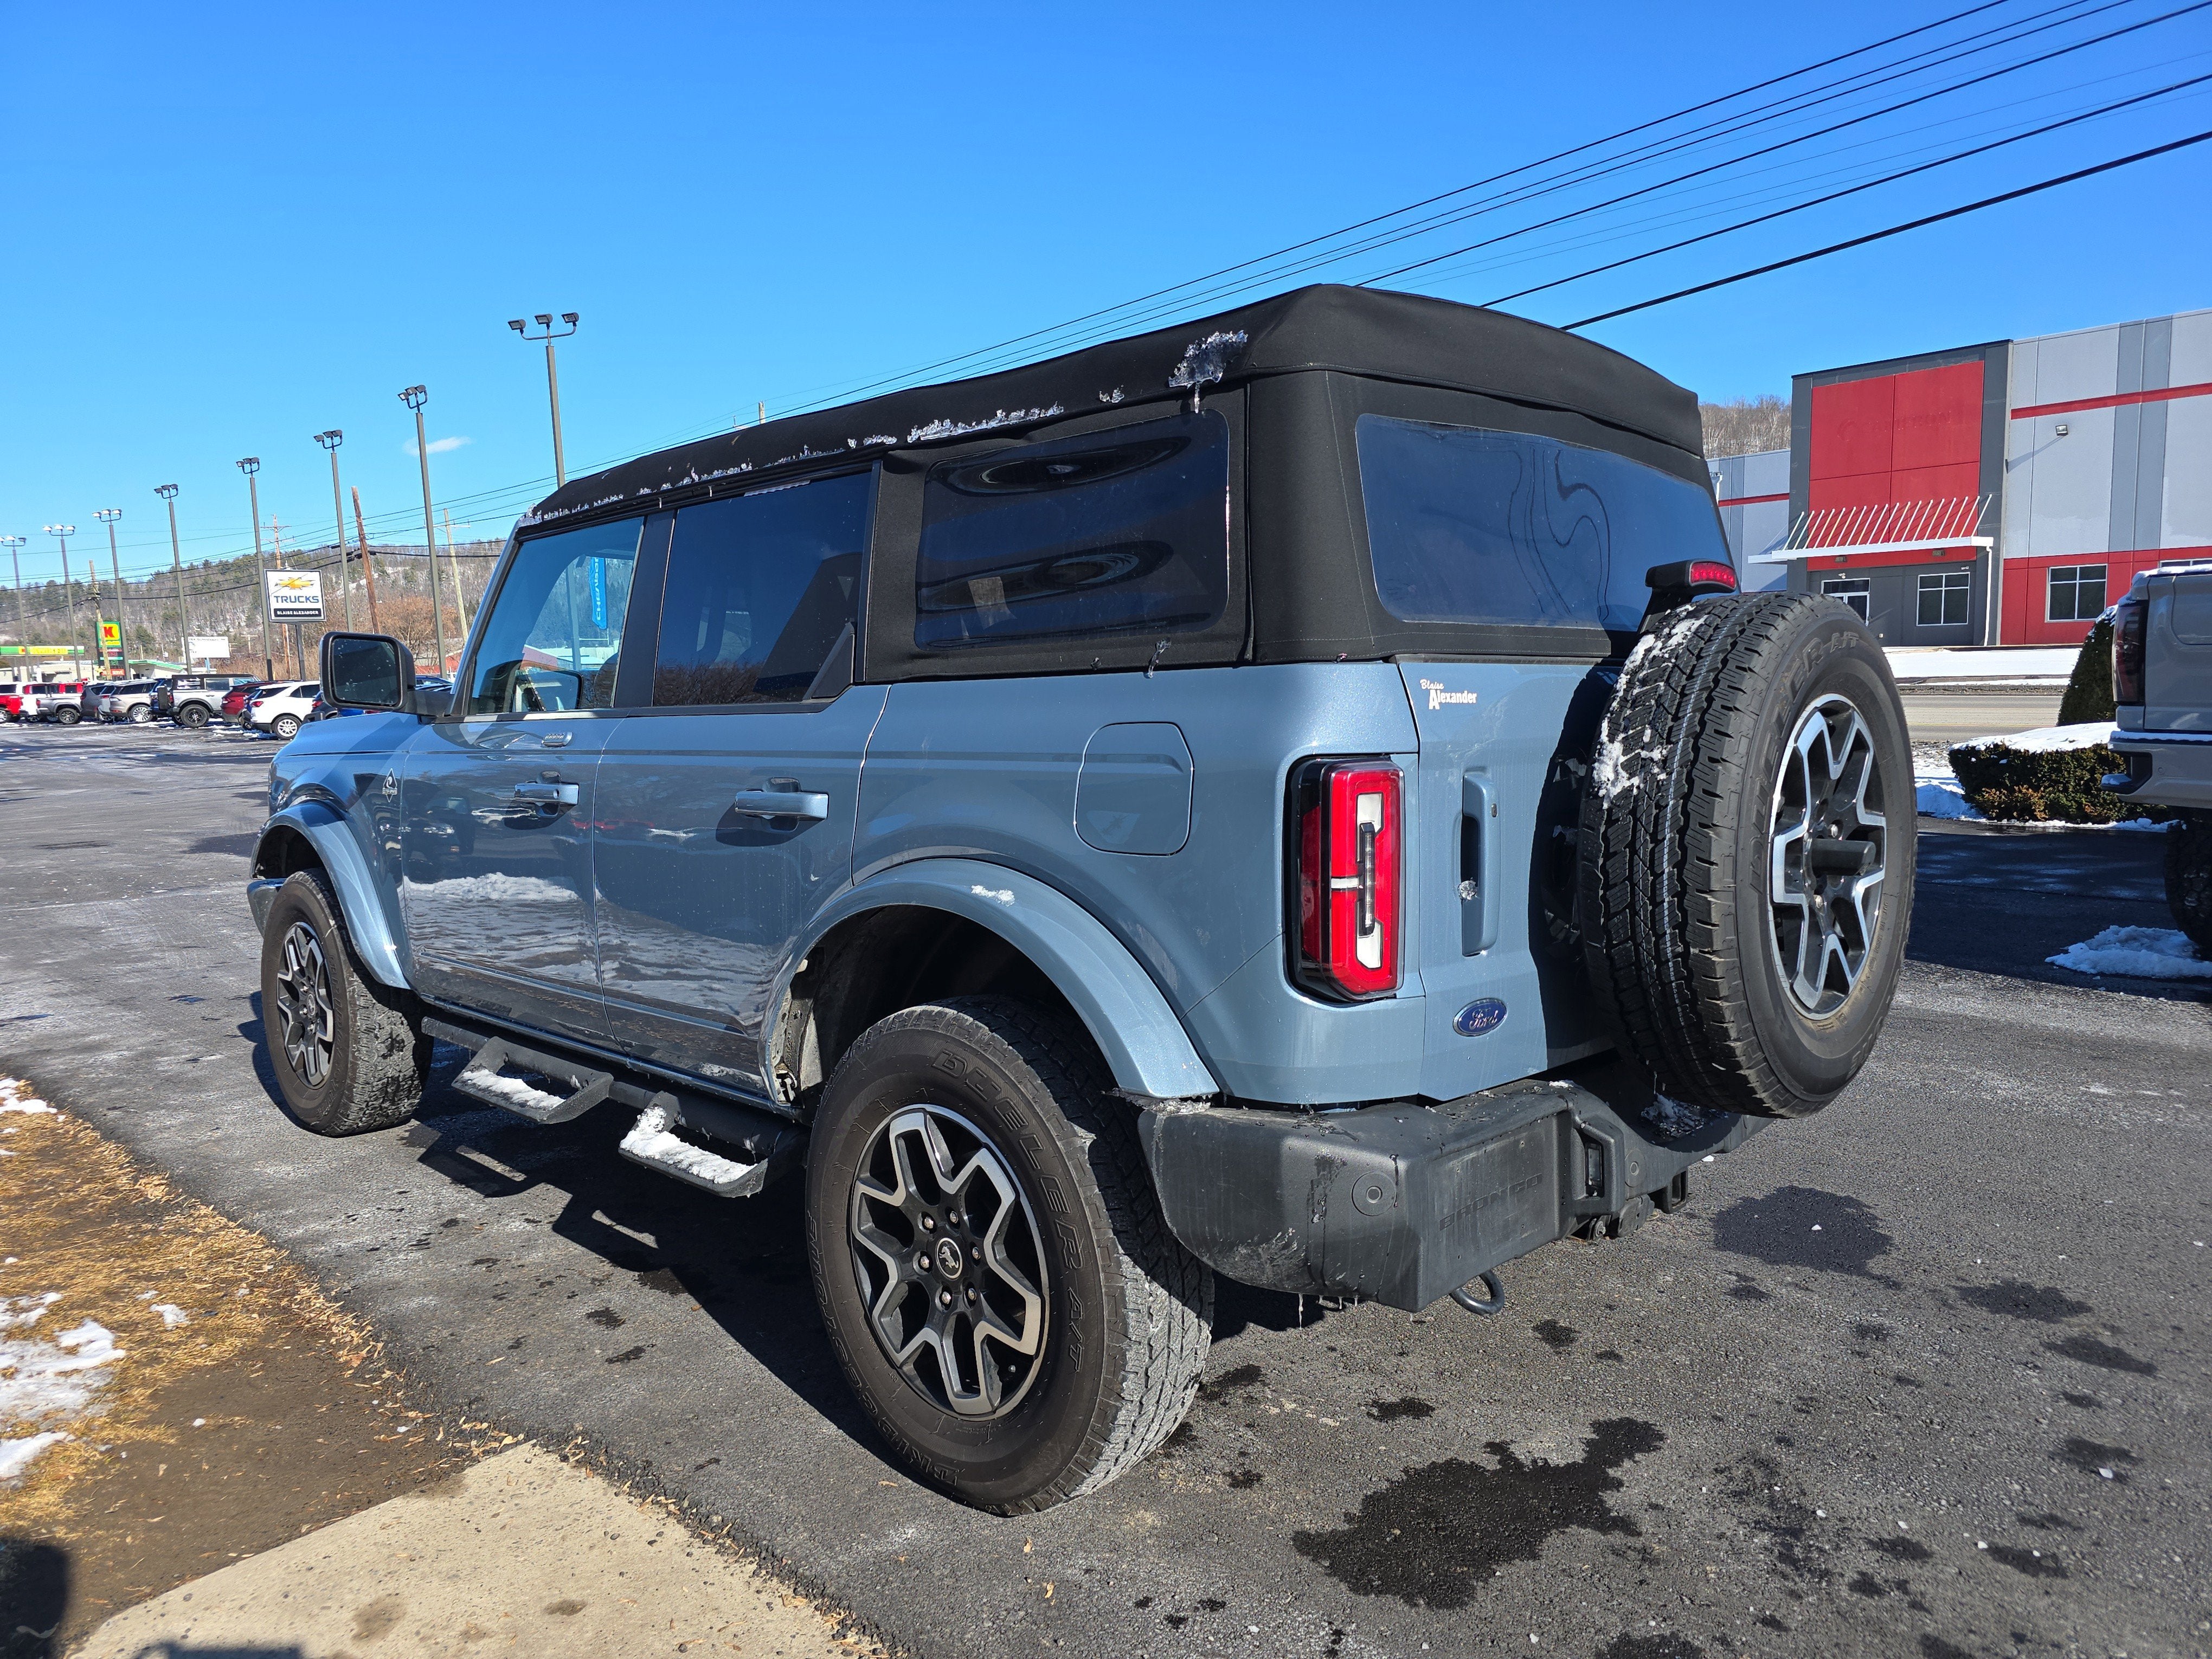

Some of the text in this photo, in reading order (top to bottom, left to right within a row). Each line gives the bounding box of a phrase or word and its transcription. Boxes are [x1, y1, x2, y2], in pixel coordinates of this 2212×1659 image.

[273, 595, 319, 603] TRUCKS
[103, 627, 115, 638] K
[1419, 679, 1445, 690] Blaise
[1429, 689, 1477, 710] Alexander
[1468, 1007, 1499, 1030] Ford
[1438, 1173, 1543, 1232] BRONCO
[1068, 1286, 1084, 1373] A/T
[807, 1209, 959, 1488] BRIDGESTONE
